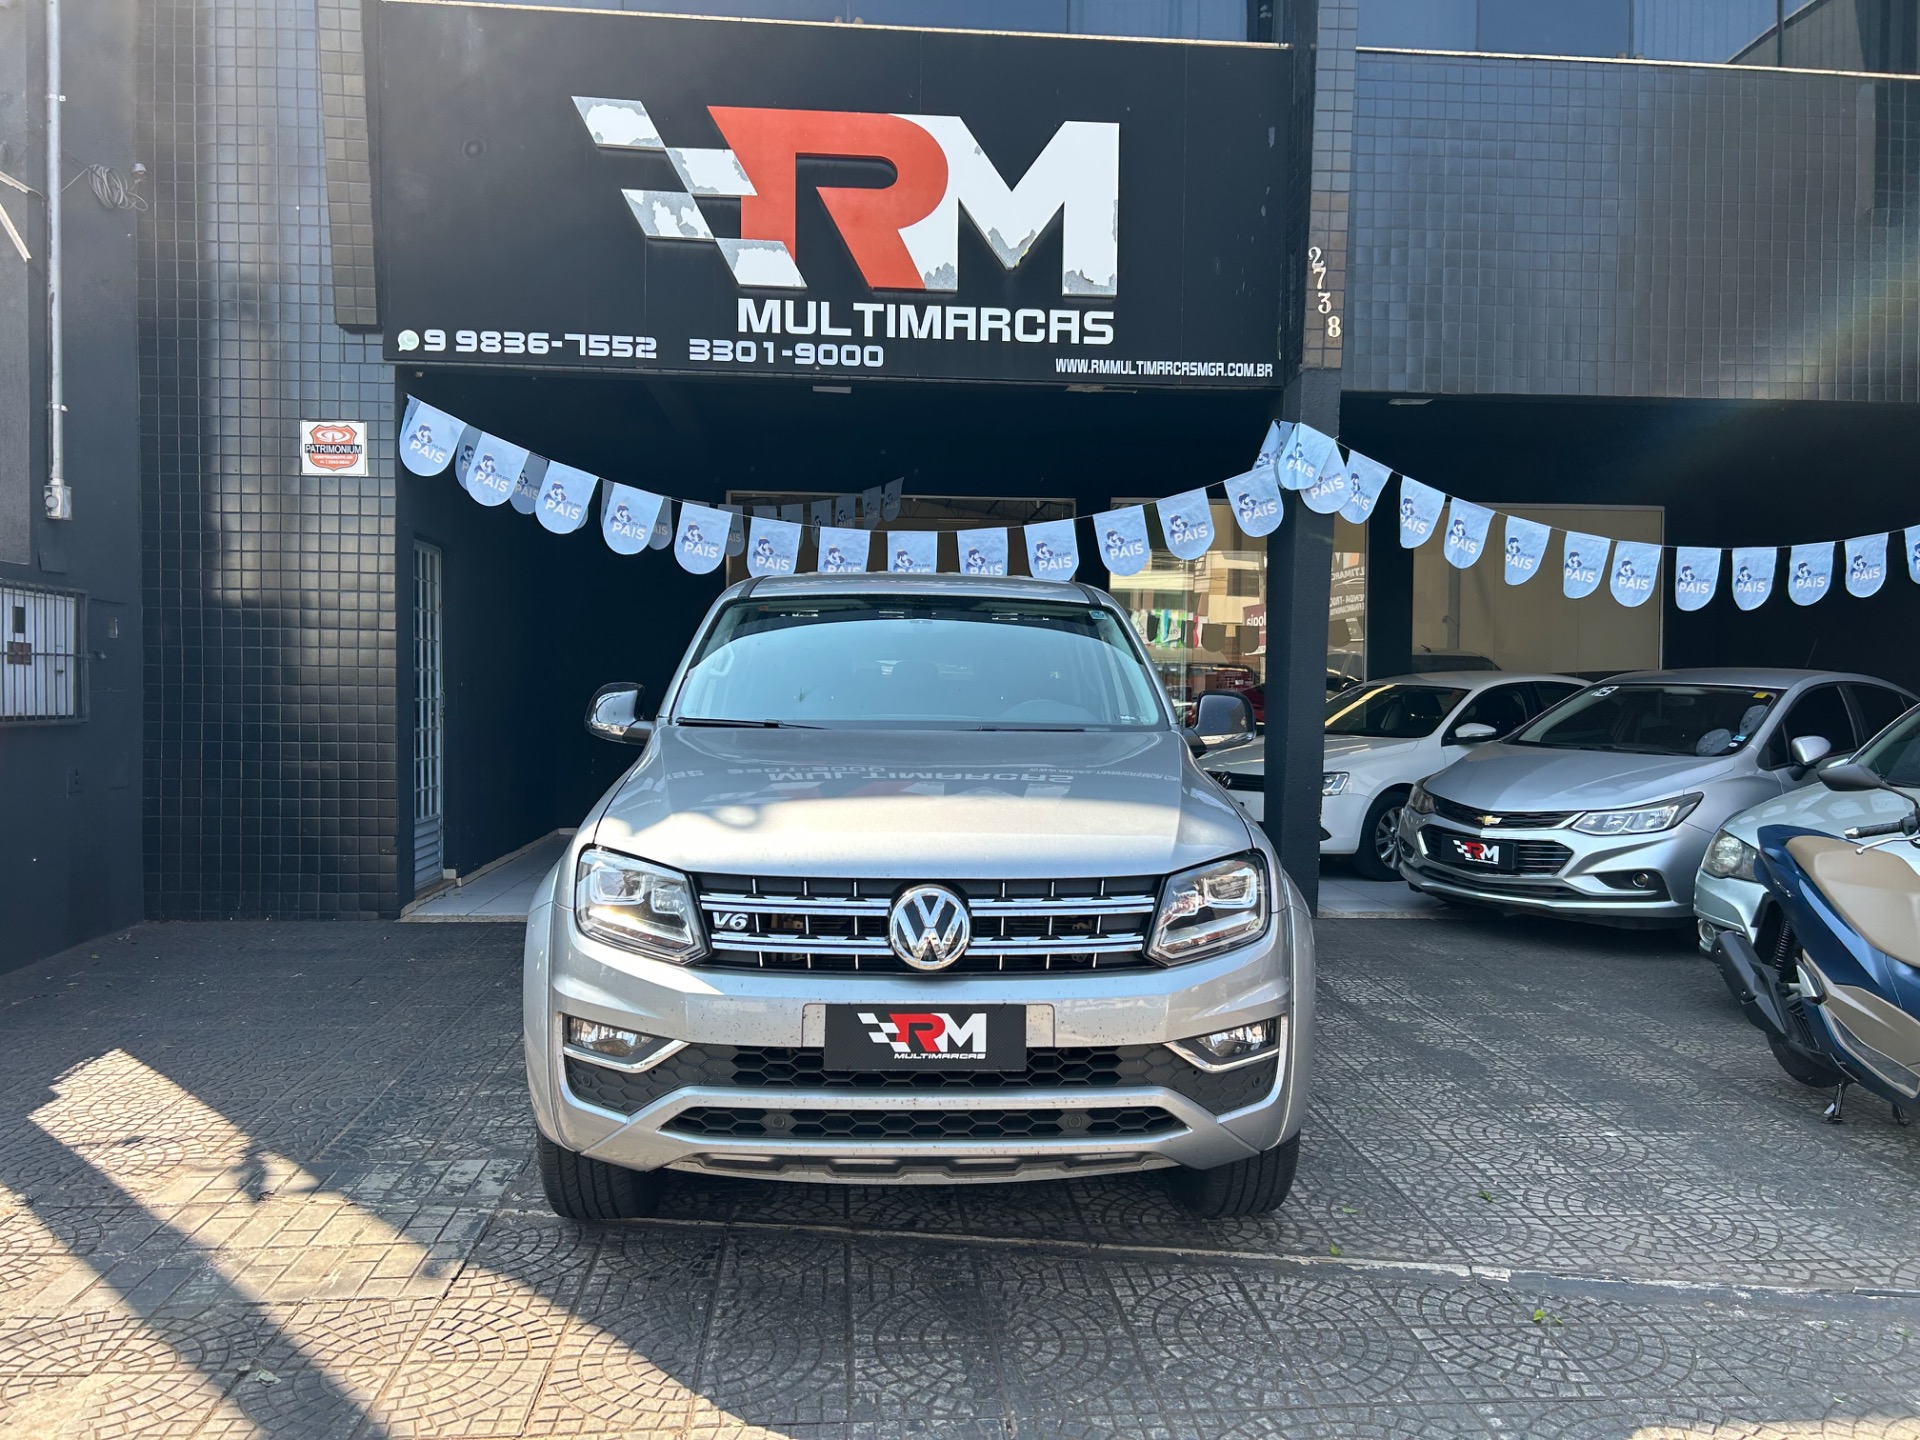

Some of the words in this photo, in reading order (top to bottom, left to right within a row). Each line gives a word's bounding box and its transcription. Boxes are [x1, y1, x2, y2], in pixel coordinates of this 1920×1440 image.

[707, 106, 1120, 297] RM
[1308, 246, 1341, 337] 2738
[737, 297, 1115, 346] MULTIMARCAS
[424, 328, 447, 351] 9
[455, 329, 657, 359] 9836-7552
[688, 338, 884, 368] 3301-9000
[1055, 358, 1273, 378] WWW.RMMULTIMARCASMGA.COM.BR
[305, 444, 362, 454] PATRIMONIUM
[409, 440, 446, 464] PAIS
[474, 470, 510, 493] PAIS
[1310, 476, 1345, 499] PAIS
[545, 499, 581, 520] PAIS
[1242, 502, 1278, 522] PAIS
[612, 521, 646, 540] PAIS
[1174, 525, 1208, 545] PAIS
[684, 541, 719, 558] PAIS
[1109, 543, 1144, 560] PAIS
[1450, 536, 1478, 554] PAIS
[756, 556, 790, 571] PAIS
[1038, 556, 1072, 572] PAIS
[1564, 568, 1596, 583] PAIS
[1618, 576, 1649, 590] PAIS
[1796, 576, 1825, 590] PAIS
[1852, 567, 1881, 582] PAIS
[1678, 582, 1710, 594] PAIS
[1737, 581, 1766, 593] PAIS
[1464, 841, 1500, 862] RM
[712, 912, 748, 930] V6
[889, 1013, 987, 1053] RM
[894, 1052, 986, 1060] MULTIMARCAS
